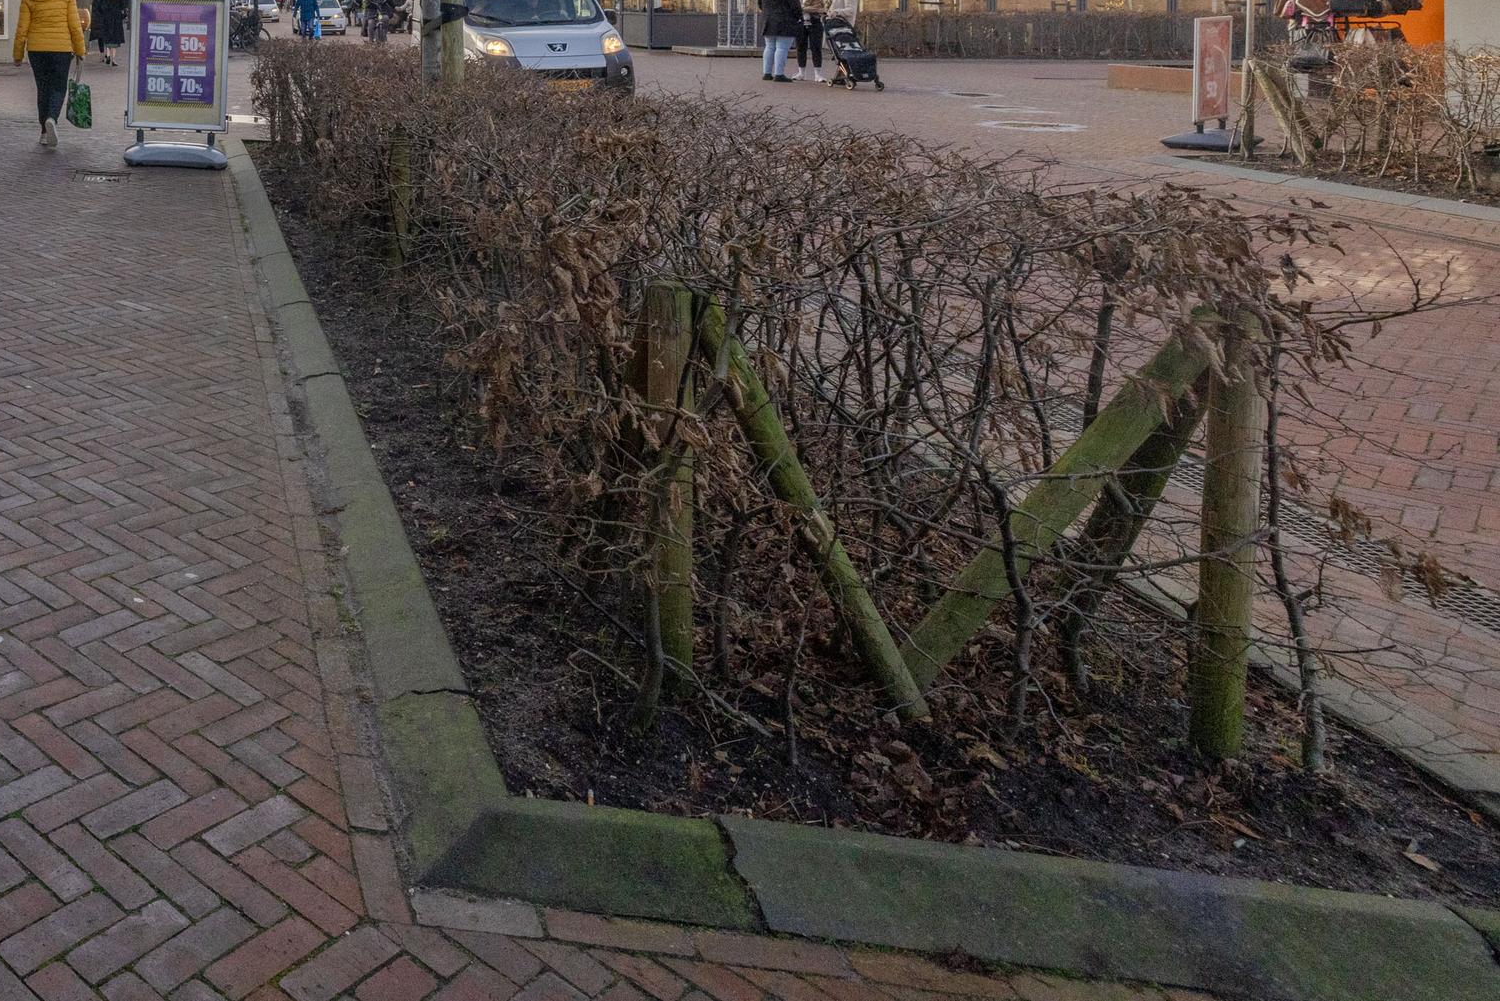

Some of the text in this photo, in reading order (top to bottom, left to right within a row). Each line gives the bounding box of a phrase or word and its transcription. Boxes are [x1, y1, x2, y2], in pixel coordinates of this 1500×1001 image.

[149, 35, 173, 51] 70%
[180, 36, 206, 52] 50%
[147, 77, 173, 93] 80%
[180, 78, 203, 94] 70%
